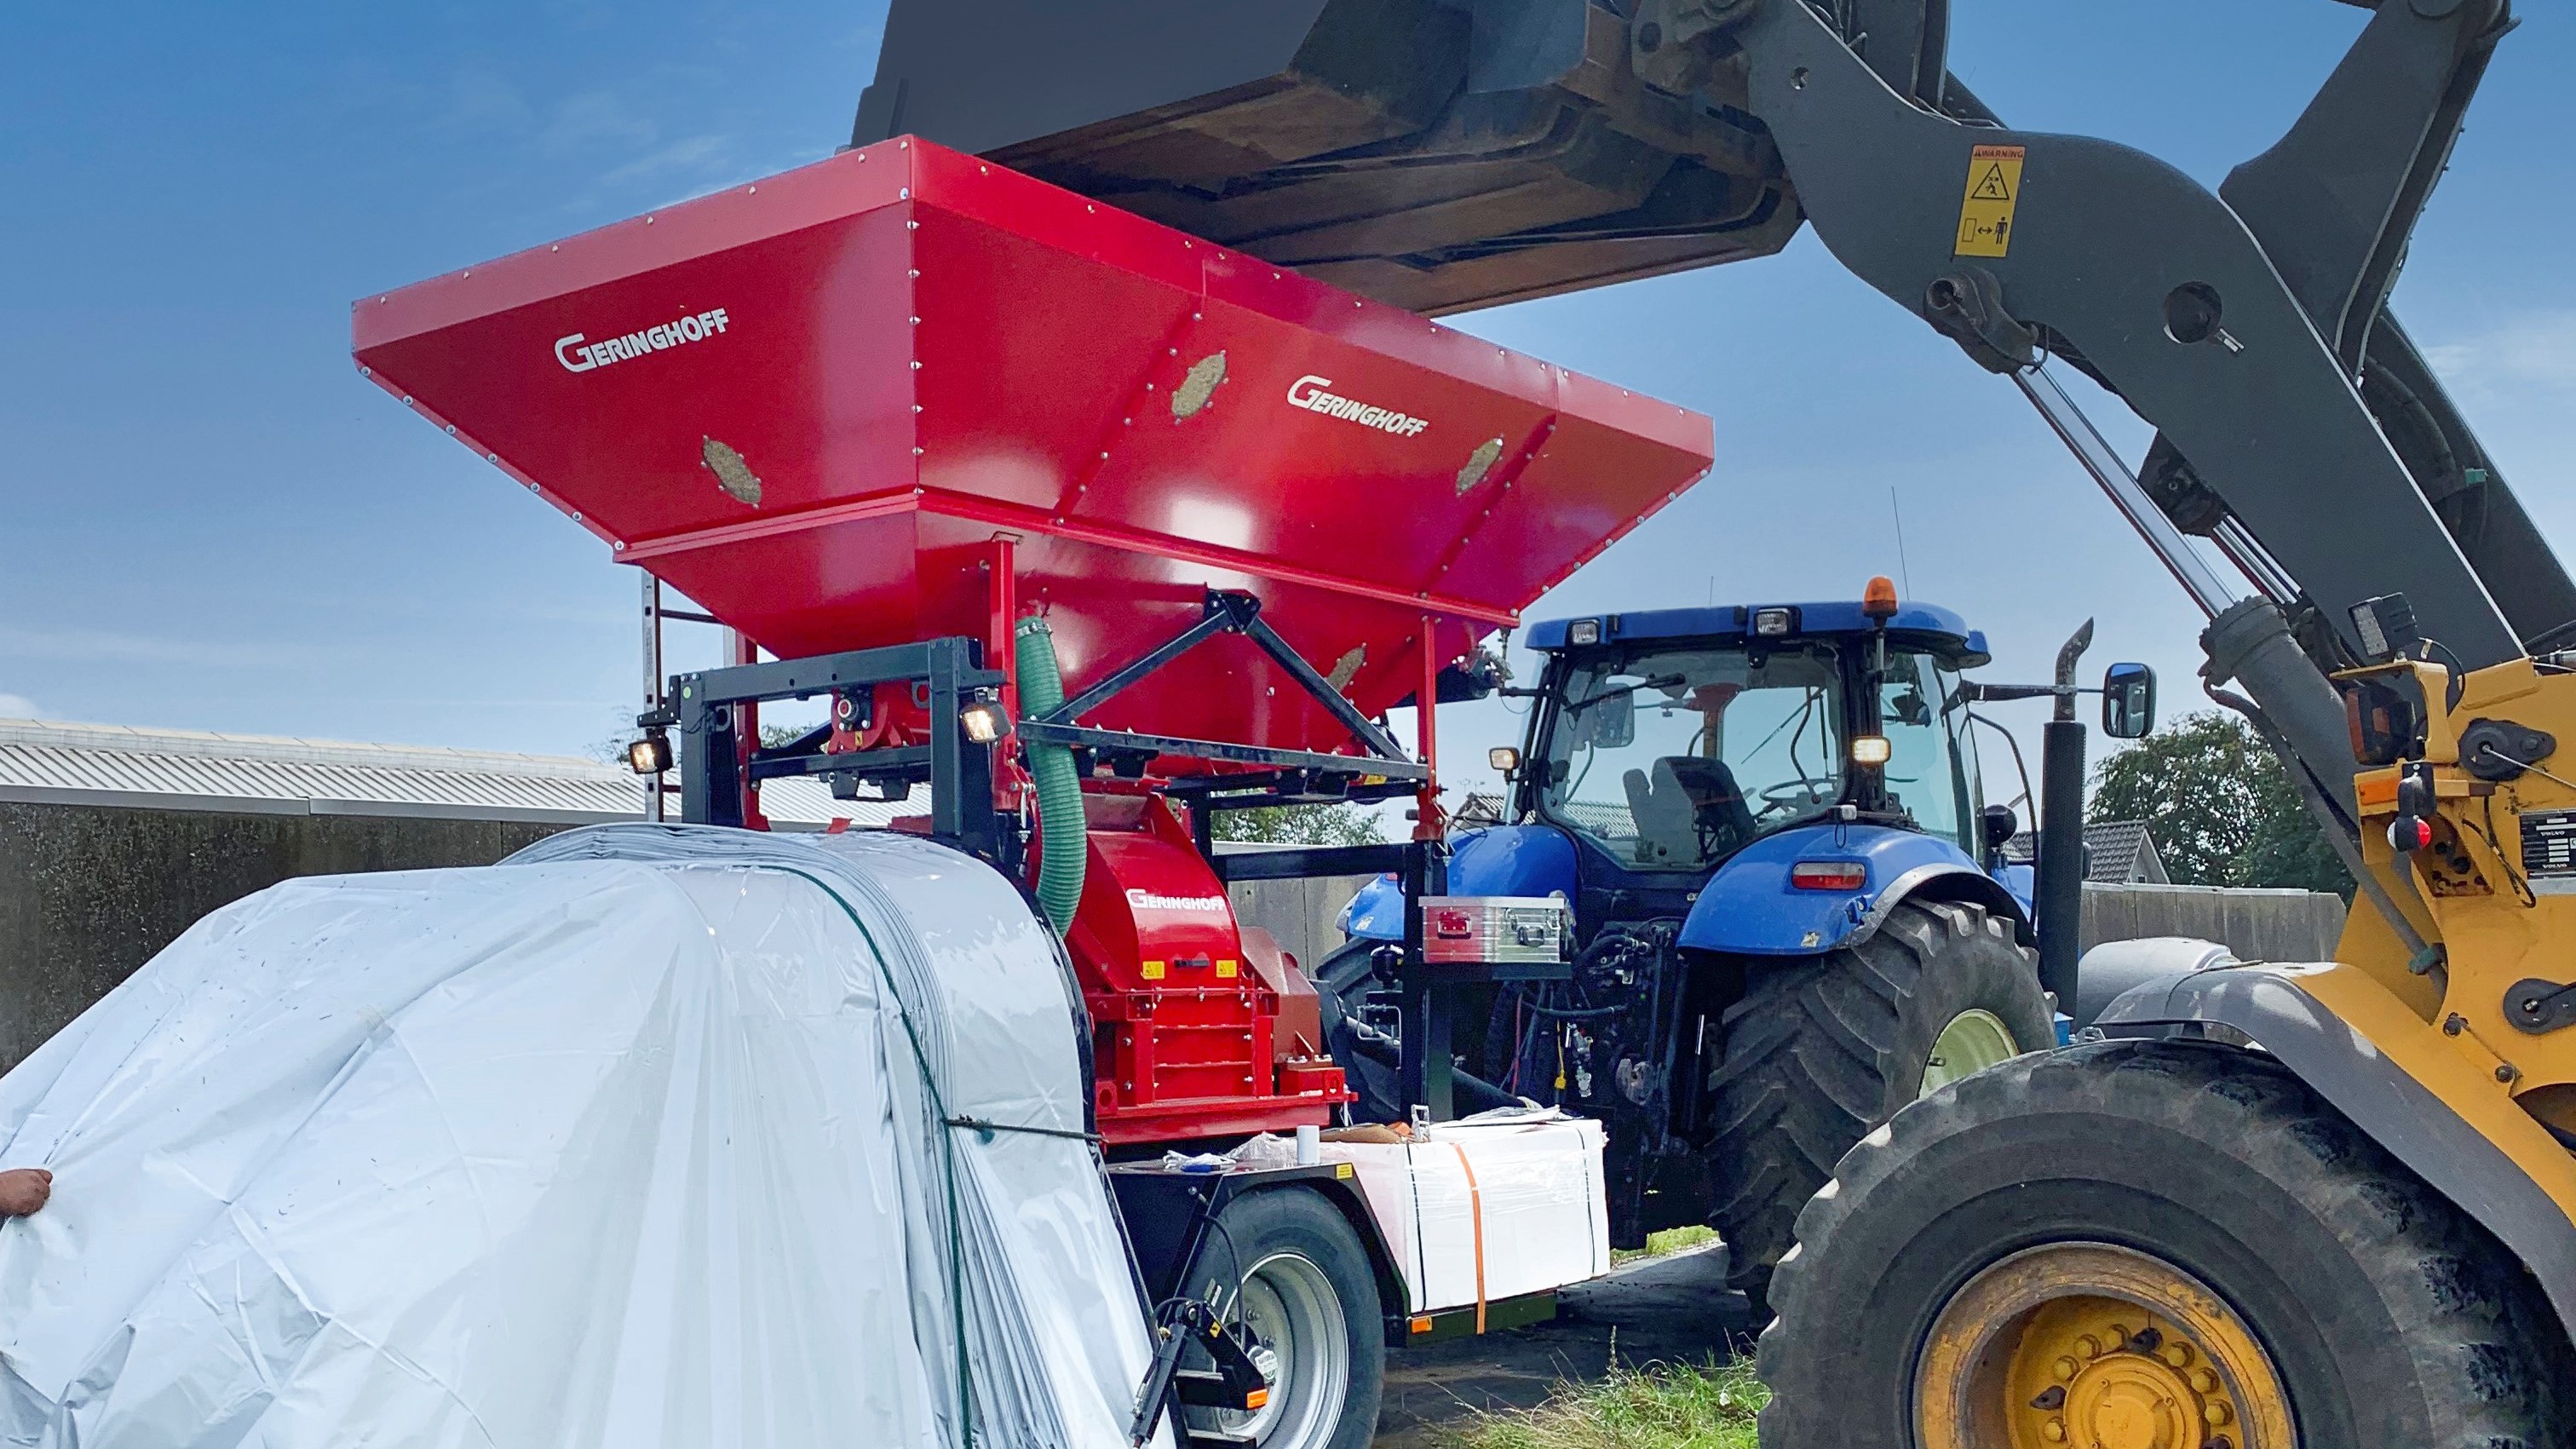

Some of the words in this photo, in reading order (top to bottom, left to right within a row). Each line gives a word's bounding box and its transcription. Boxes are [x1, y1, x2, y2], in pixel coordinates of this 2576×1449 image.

[1982, 149, 2023, 158] WARNING
[555, 308, 729, 373] GERINGHOFF
[1287, 375, 1429, 438] GERINGHOFF
[1125, 888, 1225, 911] GERINGHOFF
